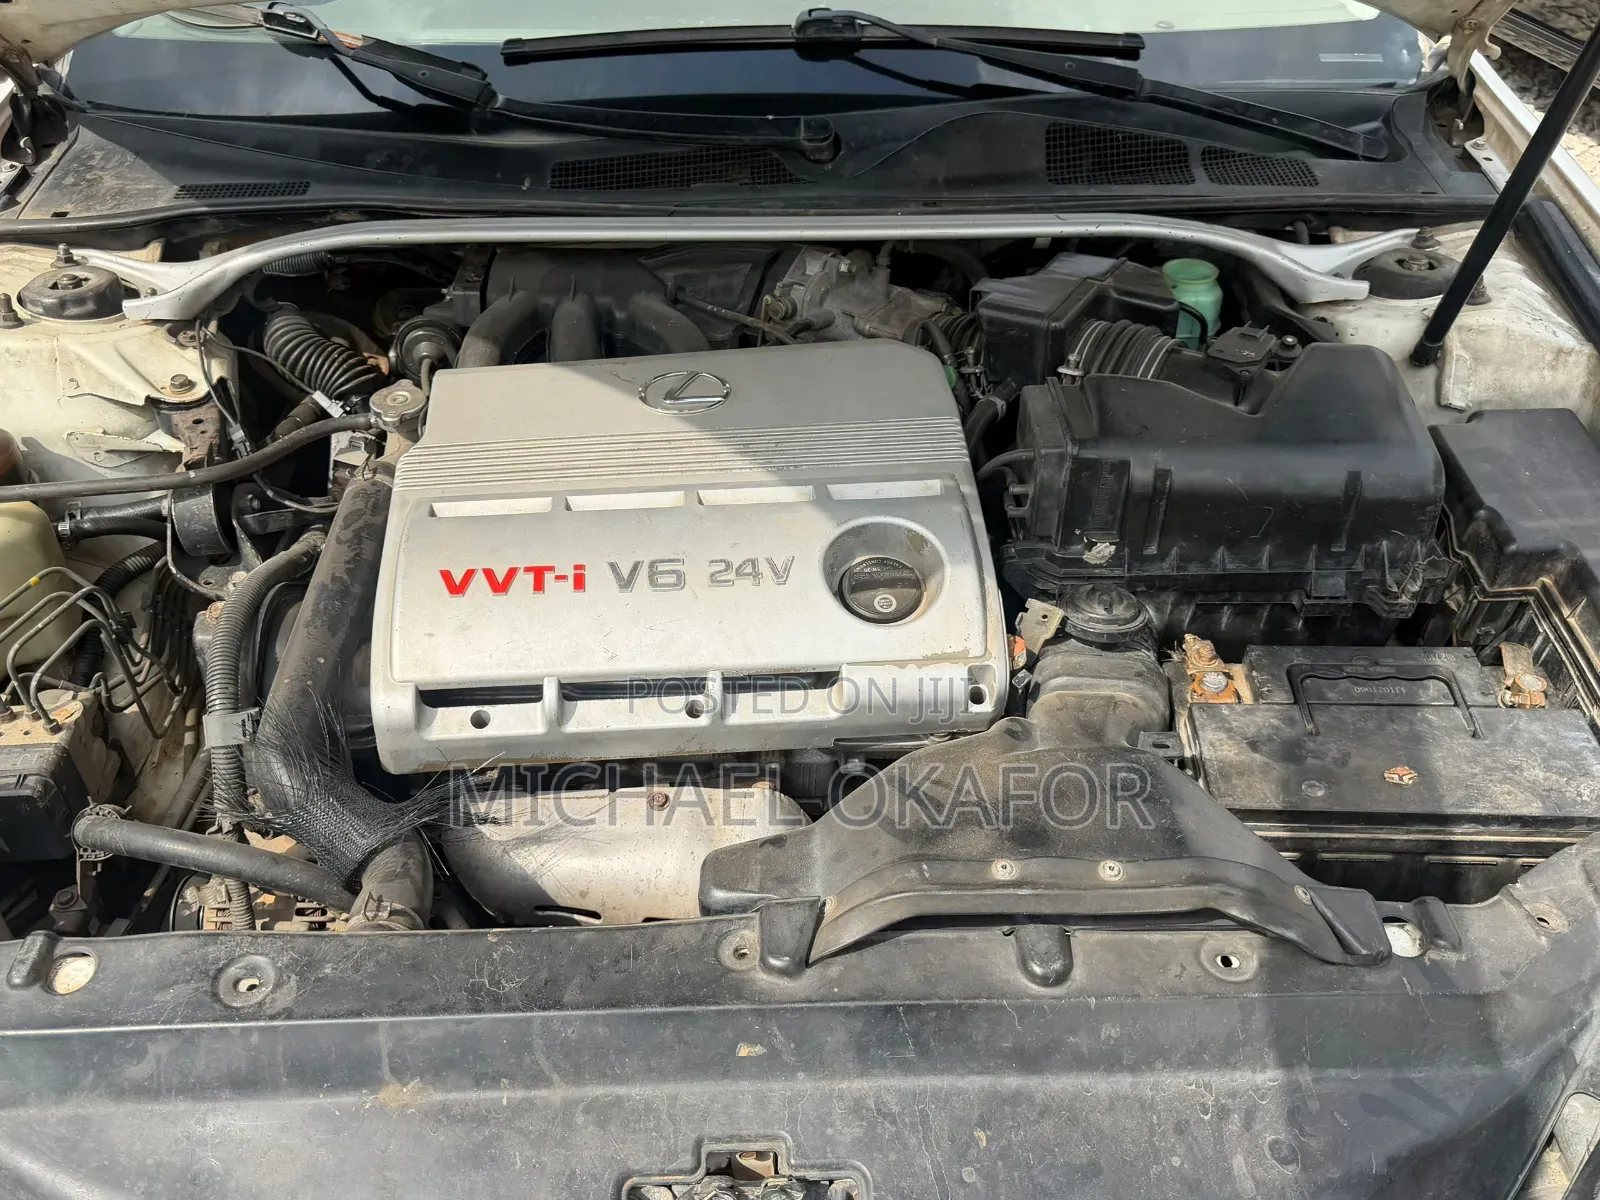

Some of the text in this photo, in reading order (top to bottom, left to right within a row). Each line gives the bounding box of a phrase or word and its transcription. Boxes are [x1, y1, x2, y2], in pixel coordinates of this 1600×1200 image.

[439, 556, 795, 598] VVT-i V6 24V
